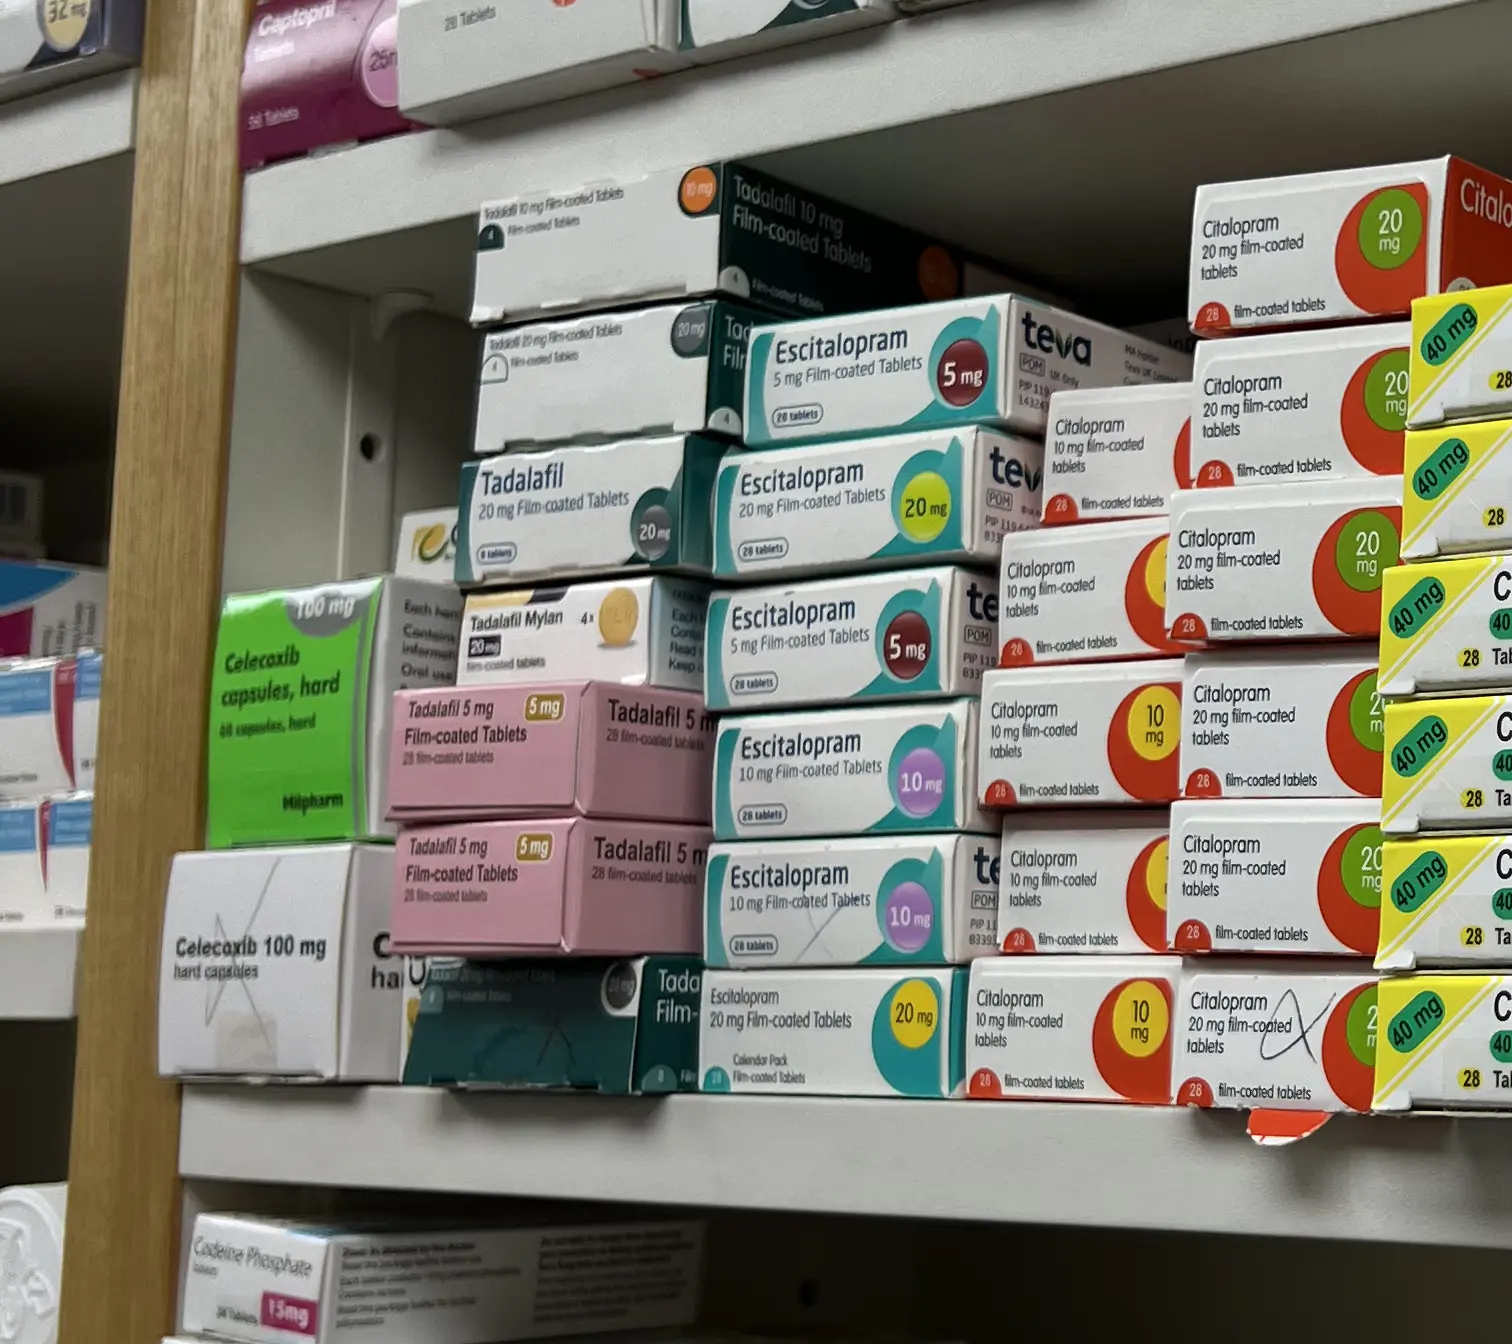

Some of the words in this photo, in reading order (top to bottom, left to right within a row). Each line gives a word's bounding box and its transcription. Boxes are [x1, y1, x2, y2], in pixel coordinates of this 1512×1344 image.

[1203, 214, 1279, 241] Citalopram
[1202, 245, 1216, 259] 20
[1219, 245, 1237, 262] mg
[1241, 235, 1304, 254] film-coated
[1201, 264, 1238, 280] tablets
[775, 328, 908, 365] Escitalopram
[1021, 312, 1091, 366] teva
[773, 373, 780, 388] 5
[783, 371, 802, 391] mg
[805, 362, 875, 384] Film-coated
[879, 354, 922, 373] Tablets
[480, 461, 564, 497] Tadalafil
[477, 499, 493, 519] 20
[495, 498, 515, 521] mg
[517, 495, 583, 517] Film-coated
[585, 491, 630, 509] Tablets
[408, 700, 459, 720] Tadalafil
[462, 700, 471, 716] 5
[473, 700, 494, 720] mg
[404, 726, 479, 744] Film-coated
[481, 725, 526, 744] Tablets
[175, 936, 259, 956] Celecoxib
[265, 936, 296, 955] 100
[299, 937, 327, 960] mg
